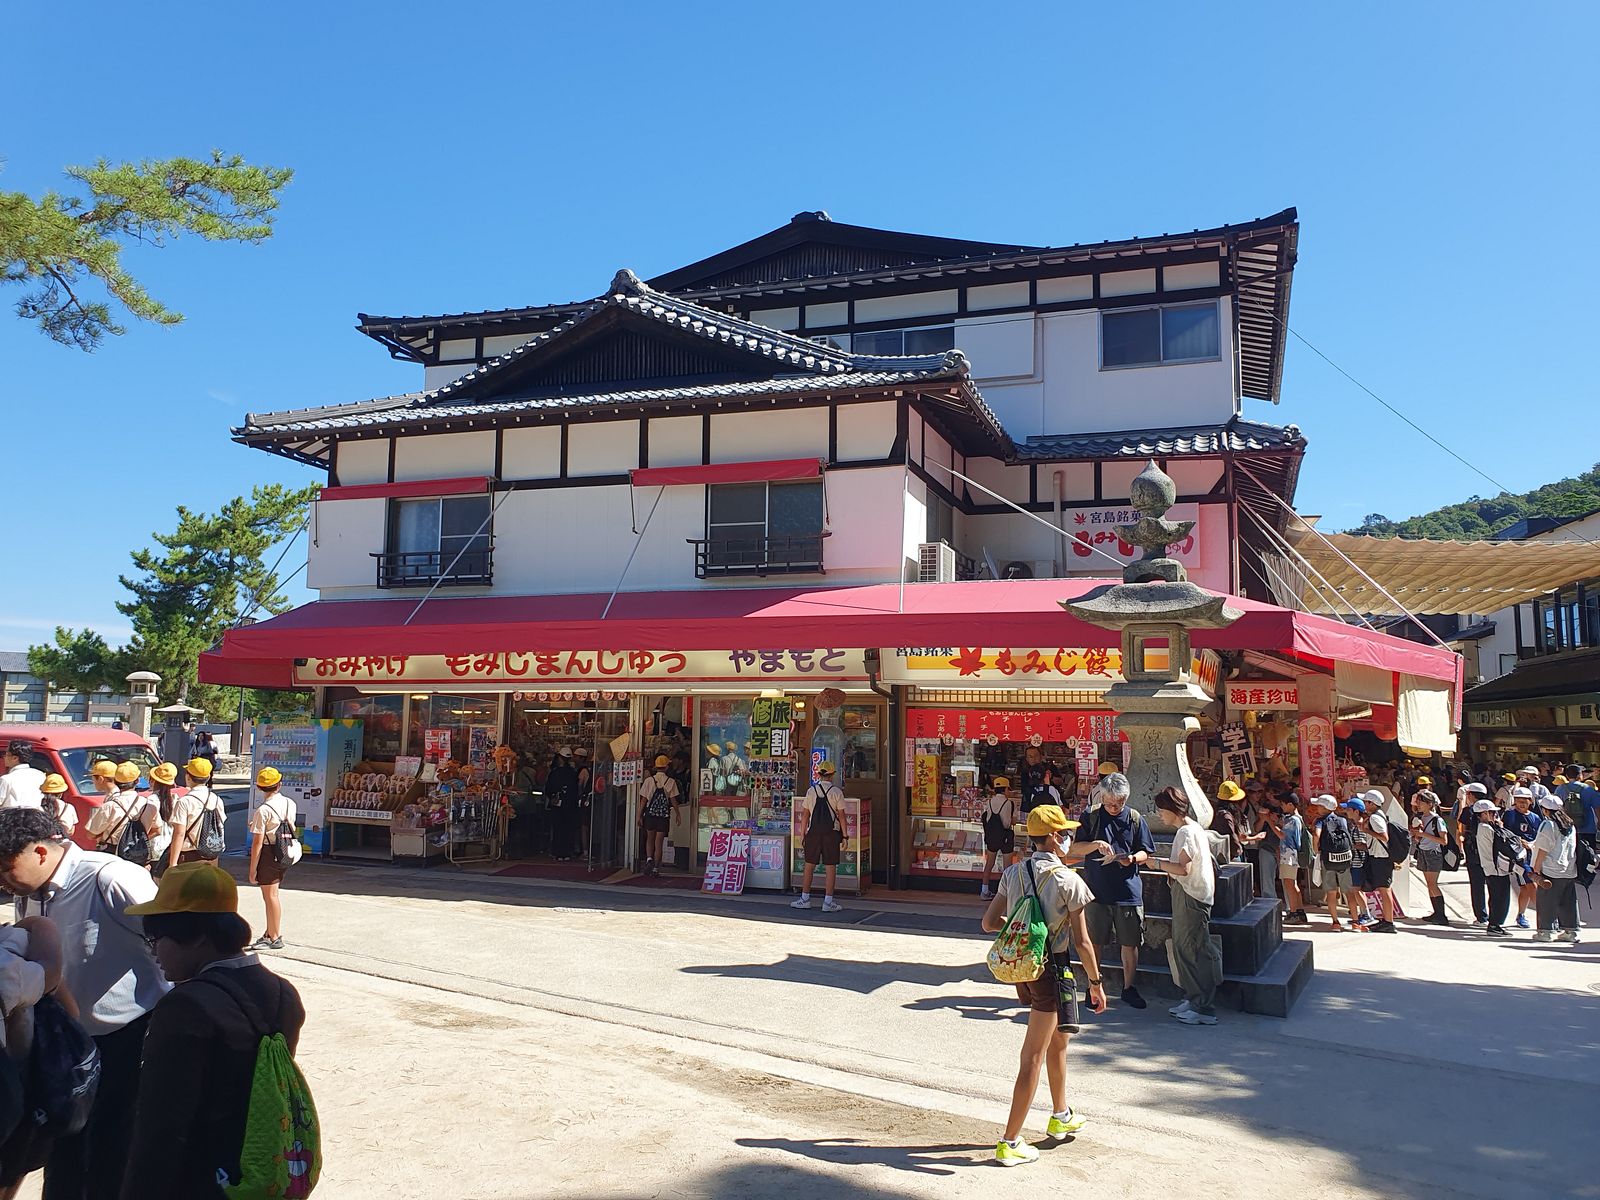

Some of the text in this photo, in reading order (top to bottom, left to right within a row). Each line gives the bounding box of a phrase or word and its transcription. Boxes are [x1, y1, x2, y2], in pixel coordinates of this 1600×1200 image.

[1090, 511, 1142, 524] 宮島銘菓
[316, 648, 845, 676] おみやげ もみじまんじゅう やまもと
[995, 647, 1123, 679] もみじ饅
[1231, 689, 1297, 704] 海産珍味
[937, 714, 945, 737] つぶあん
[980, 716, 988, 740] イチゴ
[1002, 716, 1010, 740] チーズ
[1077, 716, 1086, 740] クリーム
[1078, 743, 1095, 775] 学割
[1220, 727, 1252, 775] 学割
